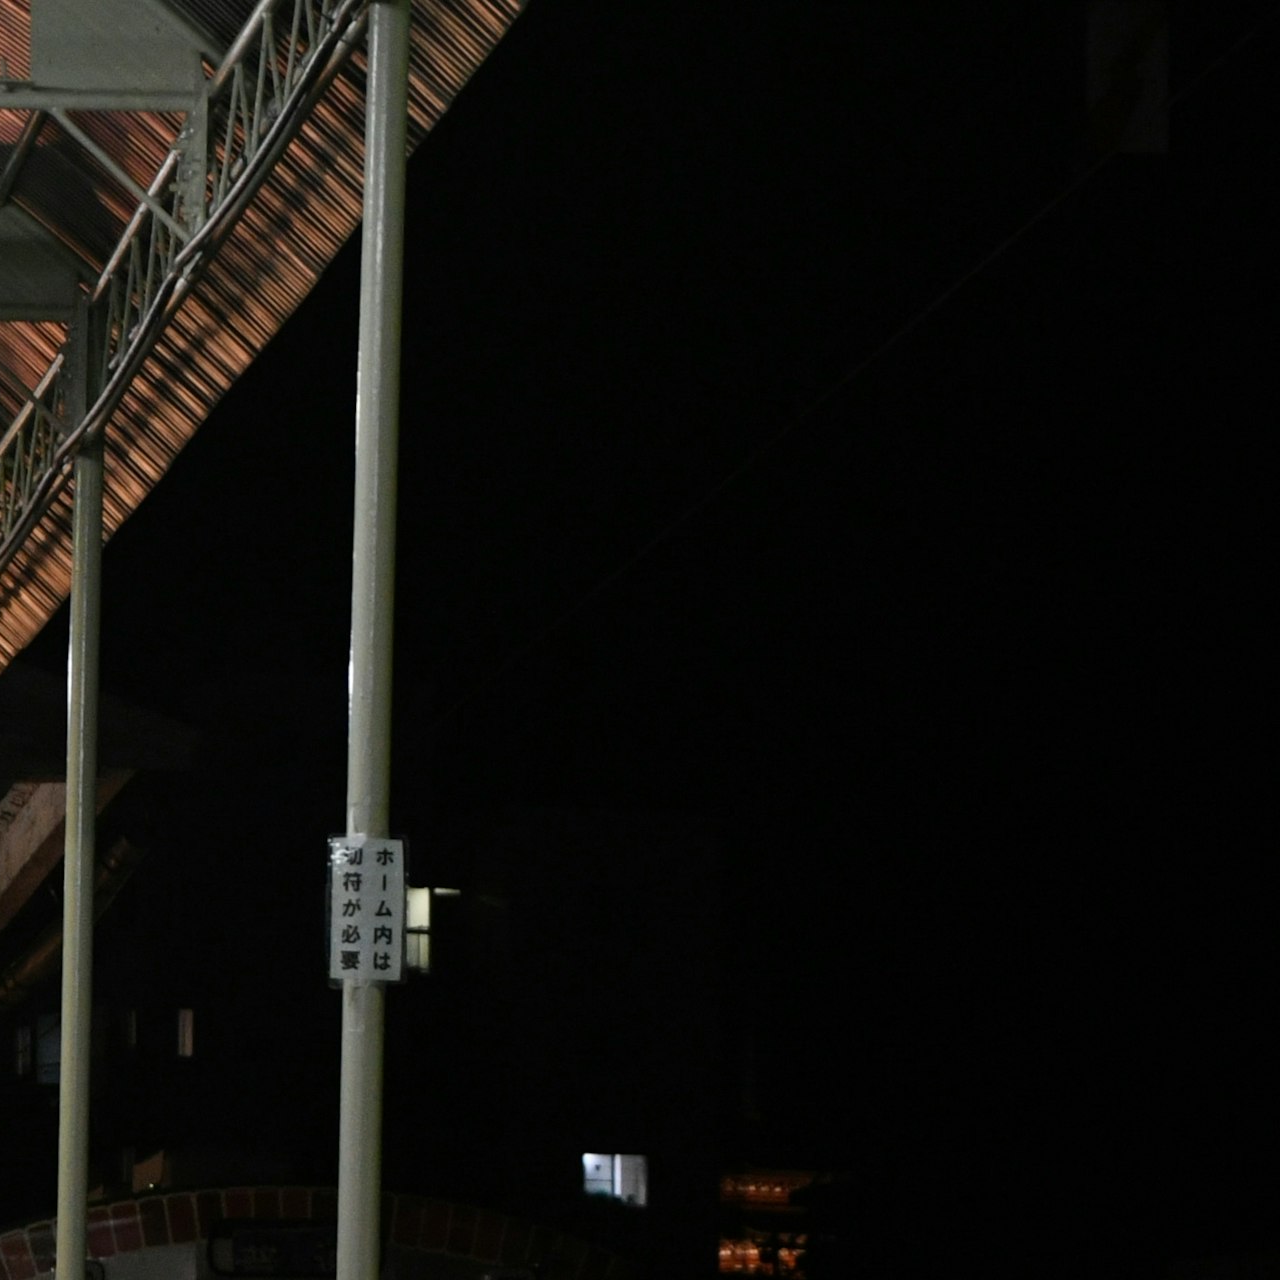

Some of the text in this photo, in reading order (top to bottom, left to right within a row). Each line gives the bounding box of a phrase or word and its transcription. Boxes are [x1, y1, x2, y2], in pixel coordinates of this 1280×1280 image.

[340, 846, 363, 971] 切符が必要
[373, 847, 395, 971] ホーム内は
